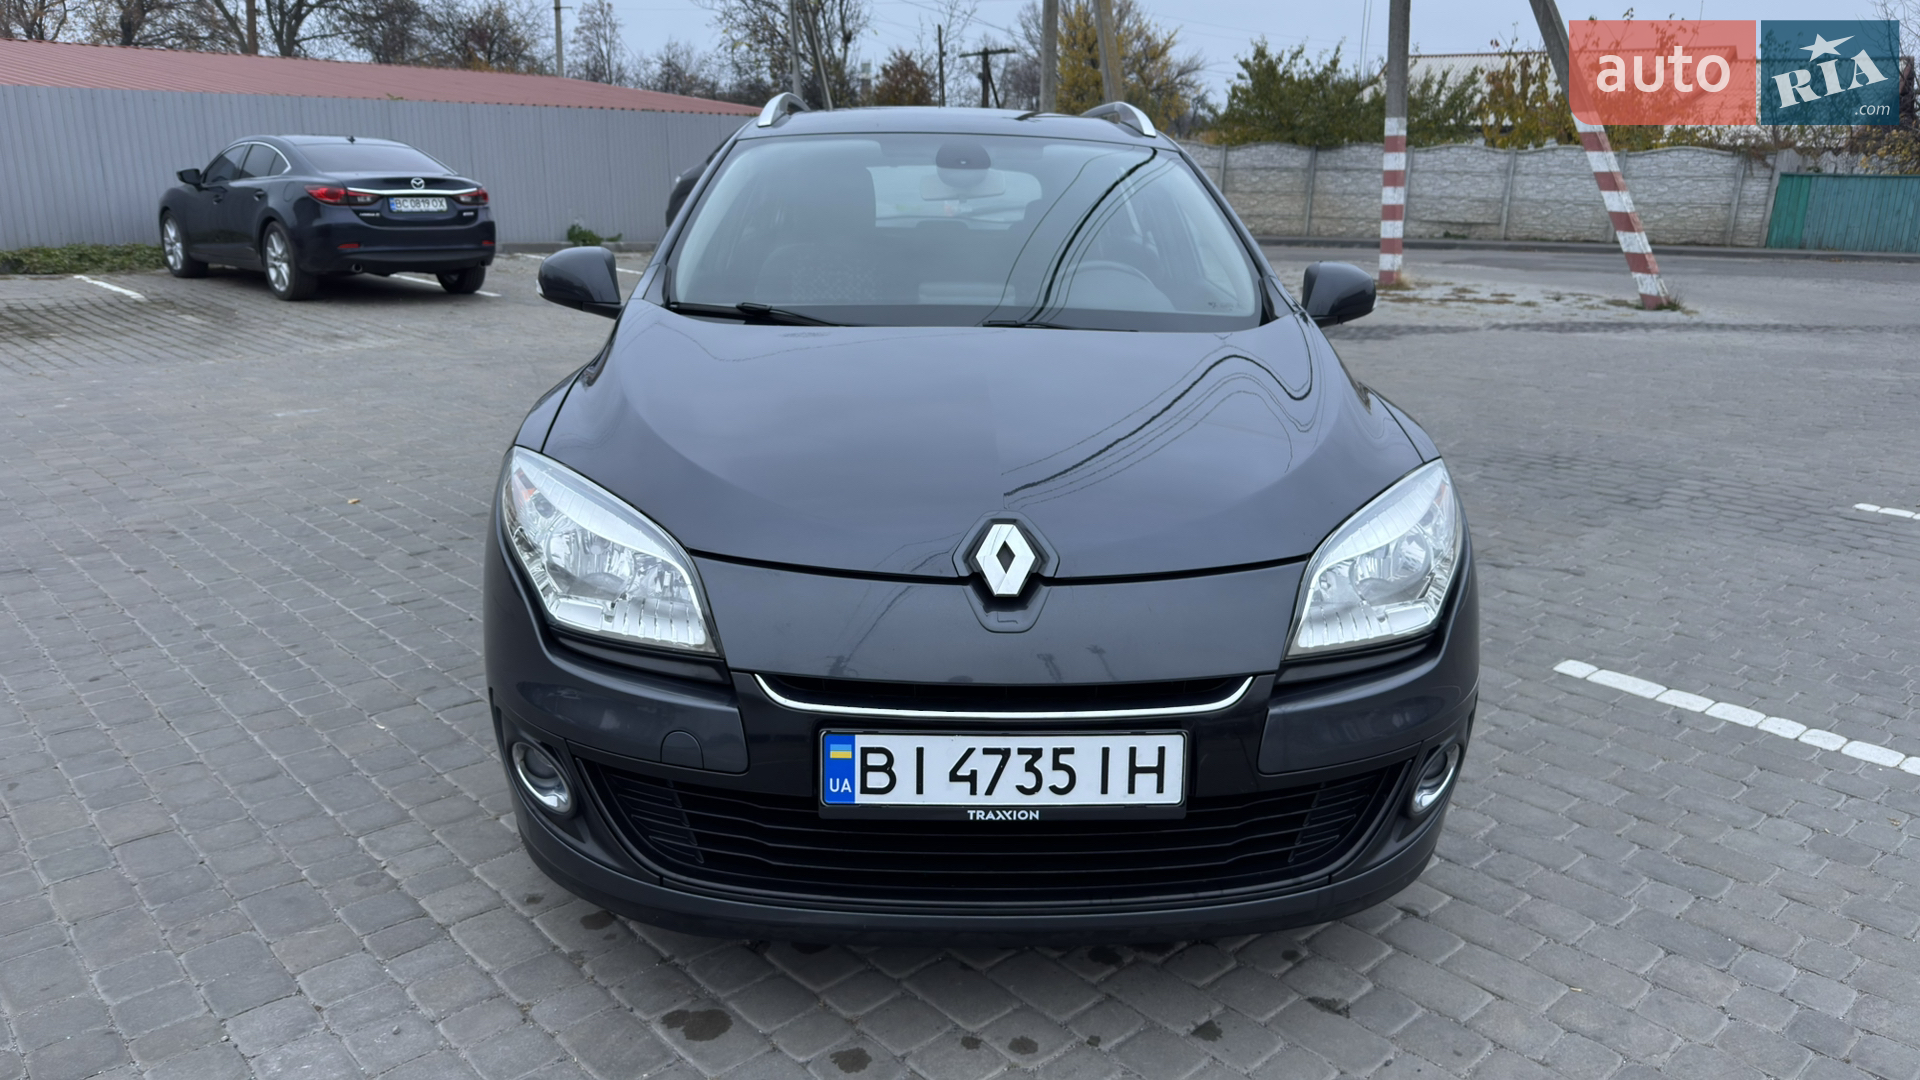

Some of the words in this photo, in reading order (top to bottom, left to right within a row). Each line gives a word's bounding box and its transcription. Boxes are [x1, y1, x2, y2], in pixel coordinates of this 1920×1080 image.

[395, 198, 409, 208] BC
[860, 746, 924, 795] BI
[948, 747, 1077, 795] 4735
[1101, 746, 1166, 794] IH
[829, 778, 852, 793] UA
[967, 810, 1040, 821] TRAXXION
